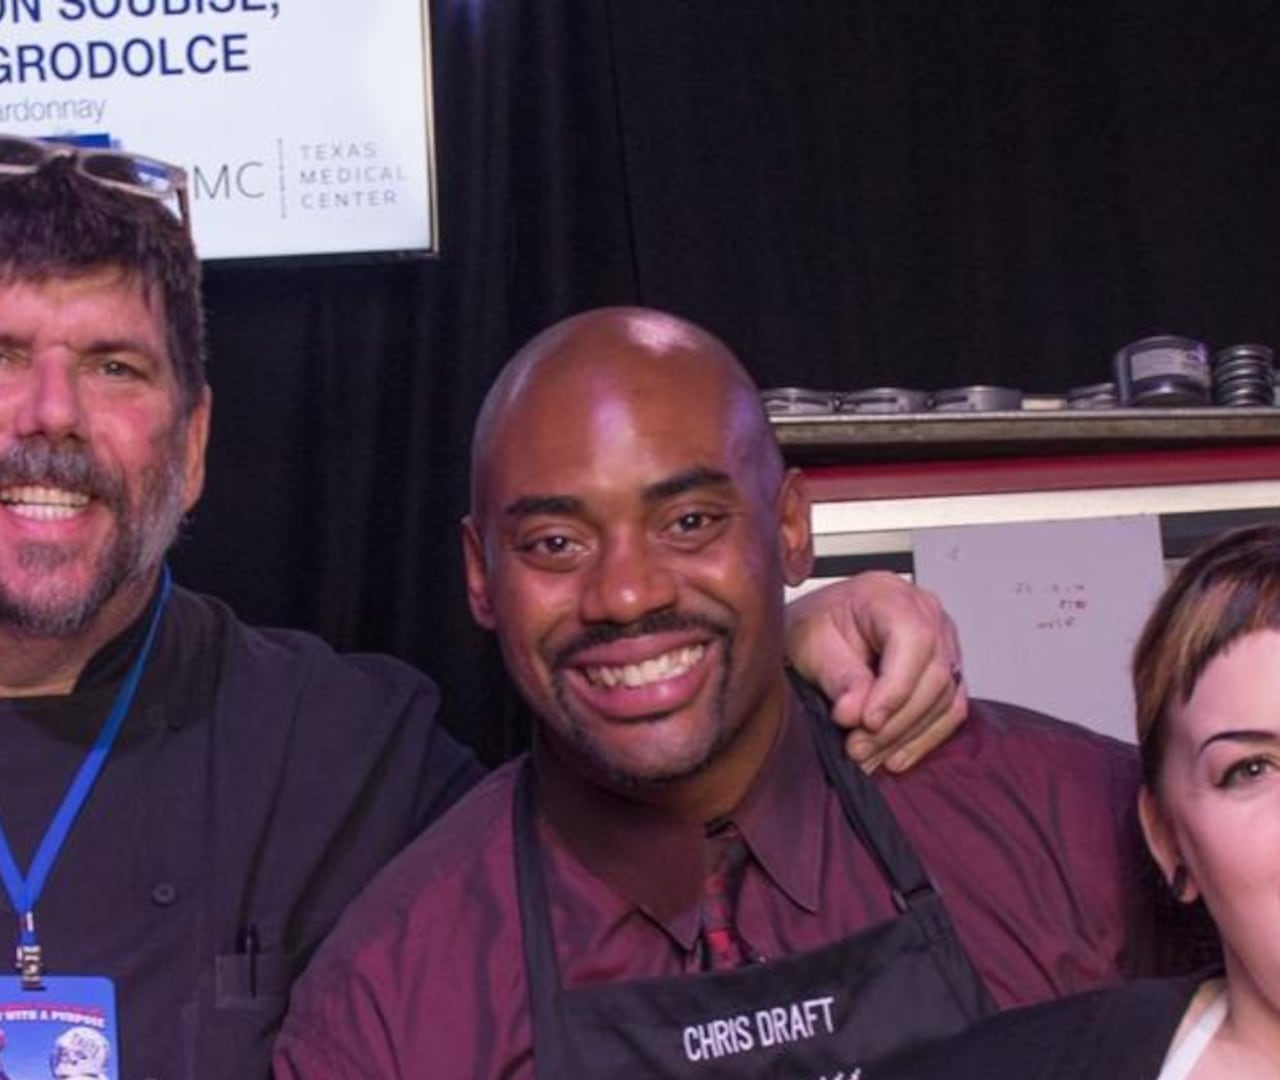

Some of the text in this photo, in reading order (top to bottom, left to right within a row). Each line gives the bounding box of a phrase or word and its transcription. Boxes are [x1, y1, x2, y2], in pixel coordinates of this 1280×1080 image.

[300, 142, 377, 160] TEXAS
[194, 161, 265, 200] MC
[300, 166, 408, 185] MEDICAL
[302, 190, 397, 209] CENTER
[683, 997, 835, 1062] CHRIS DRAFT
